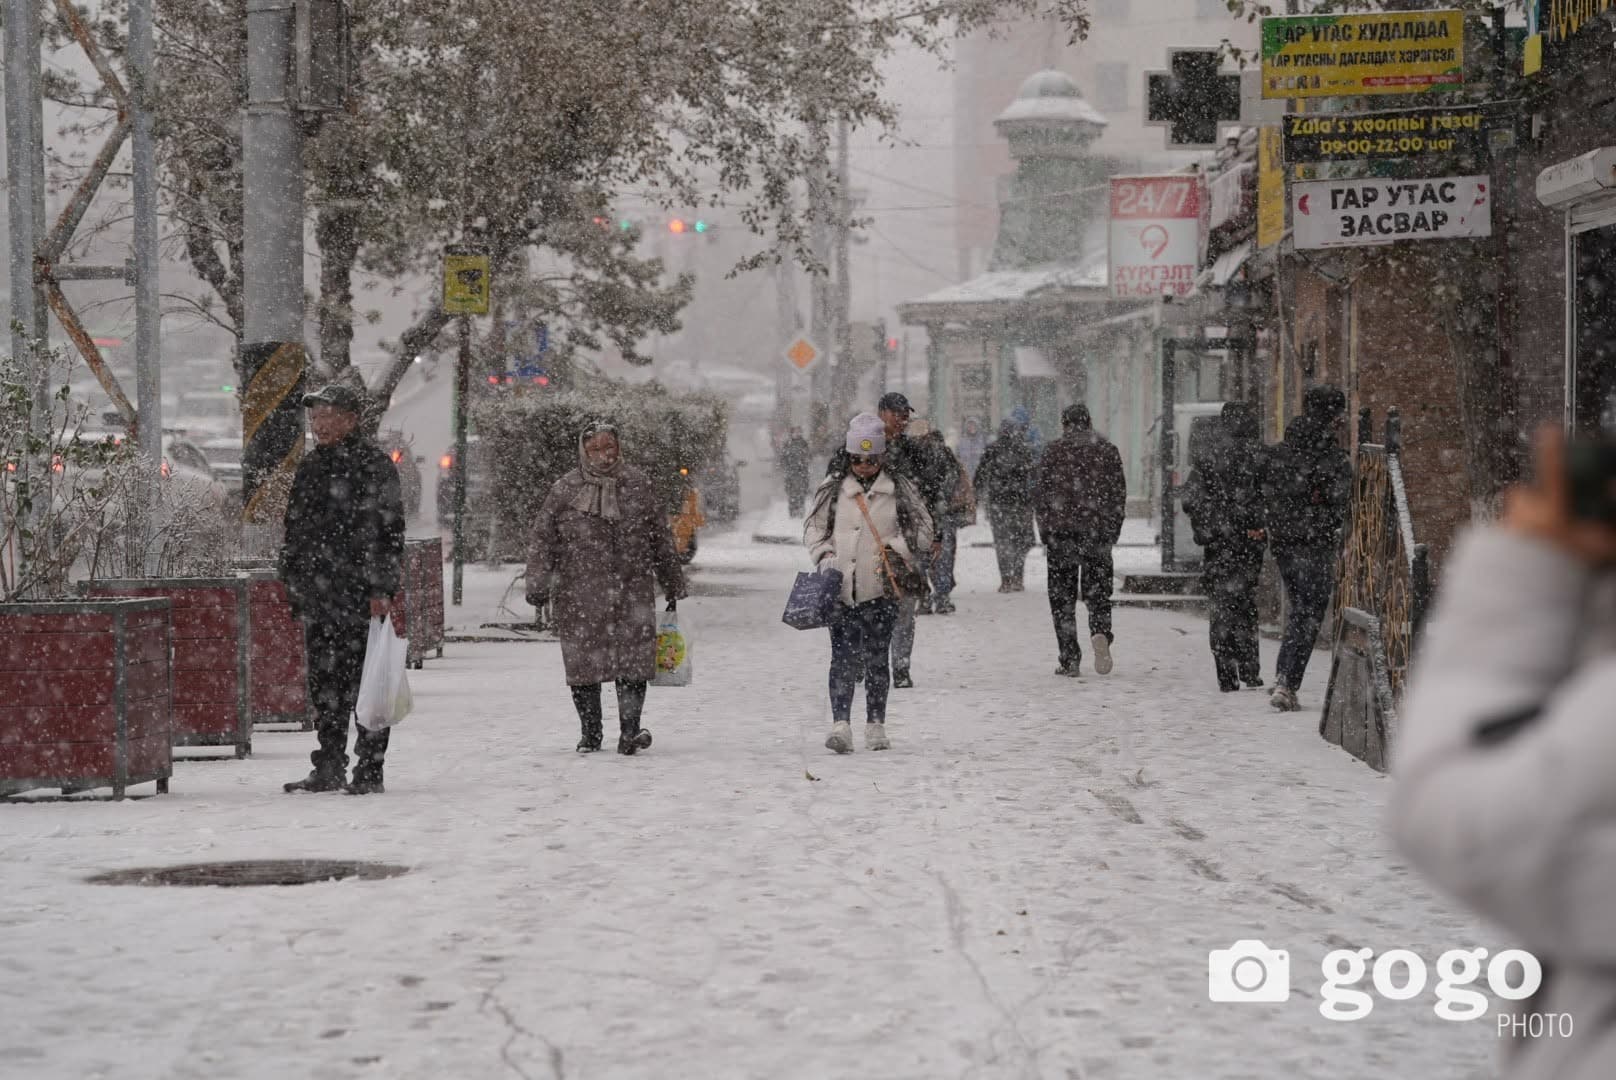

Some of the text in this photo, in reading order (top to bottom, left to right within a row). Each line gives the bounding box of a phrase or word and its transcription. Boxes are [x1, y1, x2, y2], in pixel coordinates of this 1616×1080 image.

[1276, 20, 1450, 44] ГАР УТАС ХУДАЛДАА
[1271, 48, 1456, 68] ГАР УТАСНЫ ДАГАЛДАХ ХЭРЭГСЭЛ
[1320, 136, 1424, 155] 09:00-22:00
[1117, 182, 1192, 214] 24/7
[1330, 182, 1457, 210] ГАР УТАС
[1340, 210, 1449, 237] ЗАСВАР
